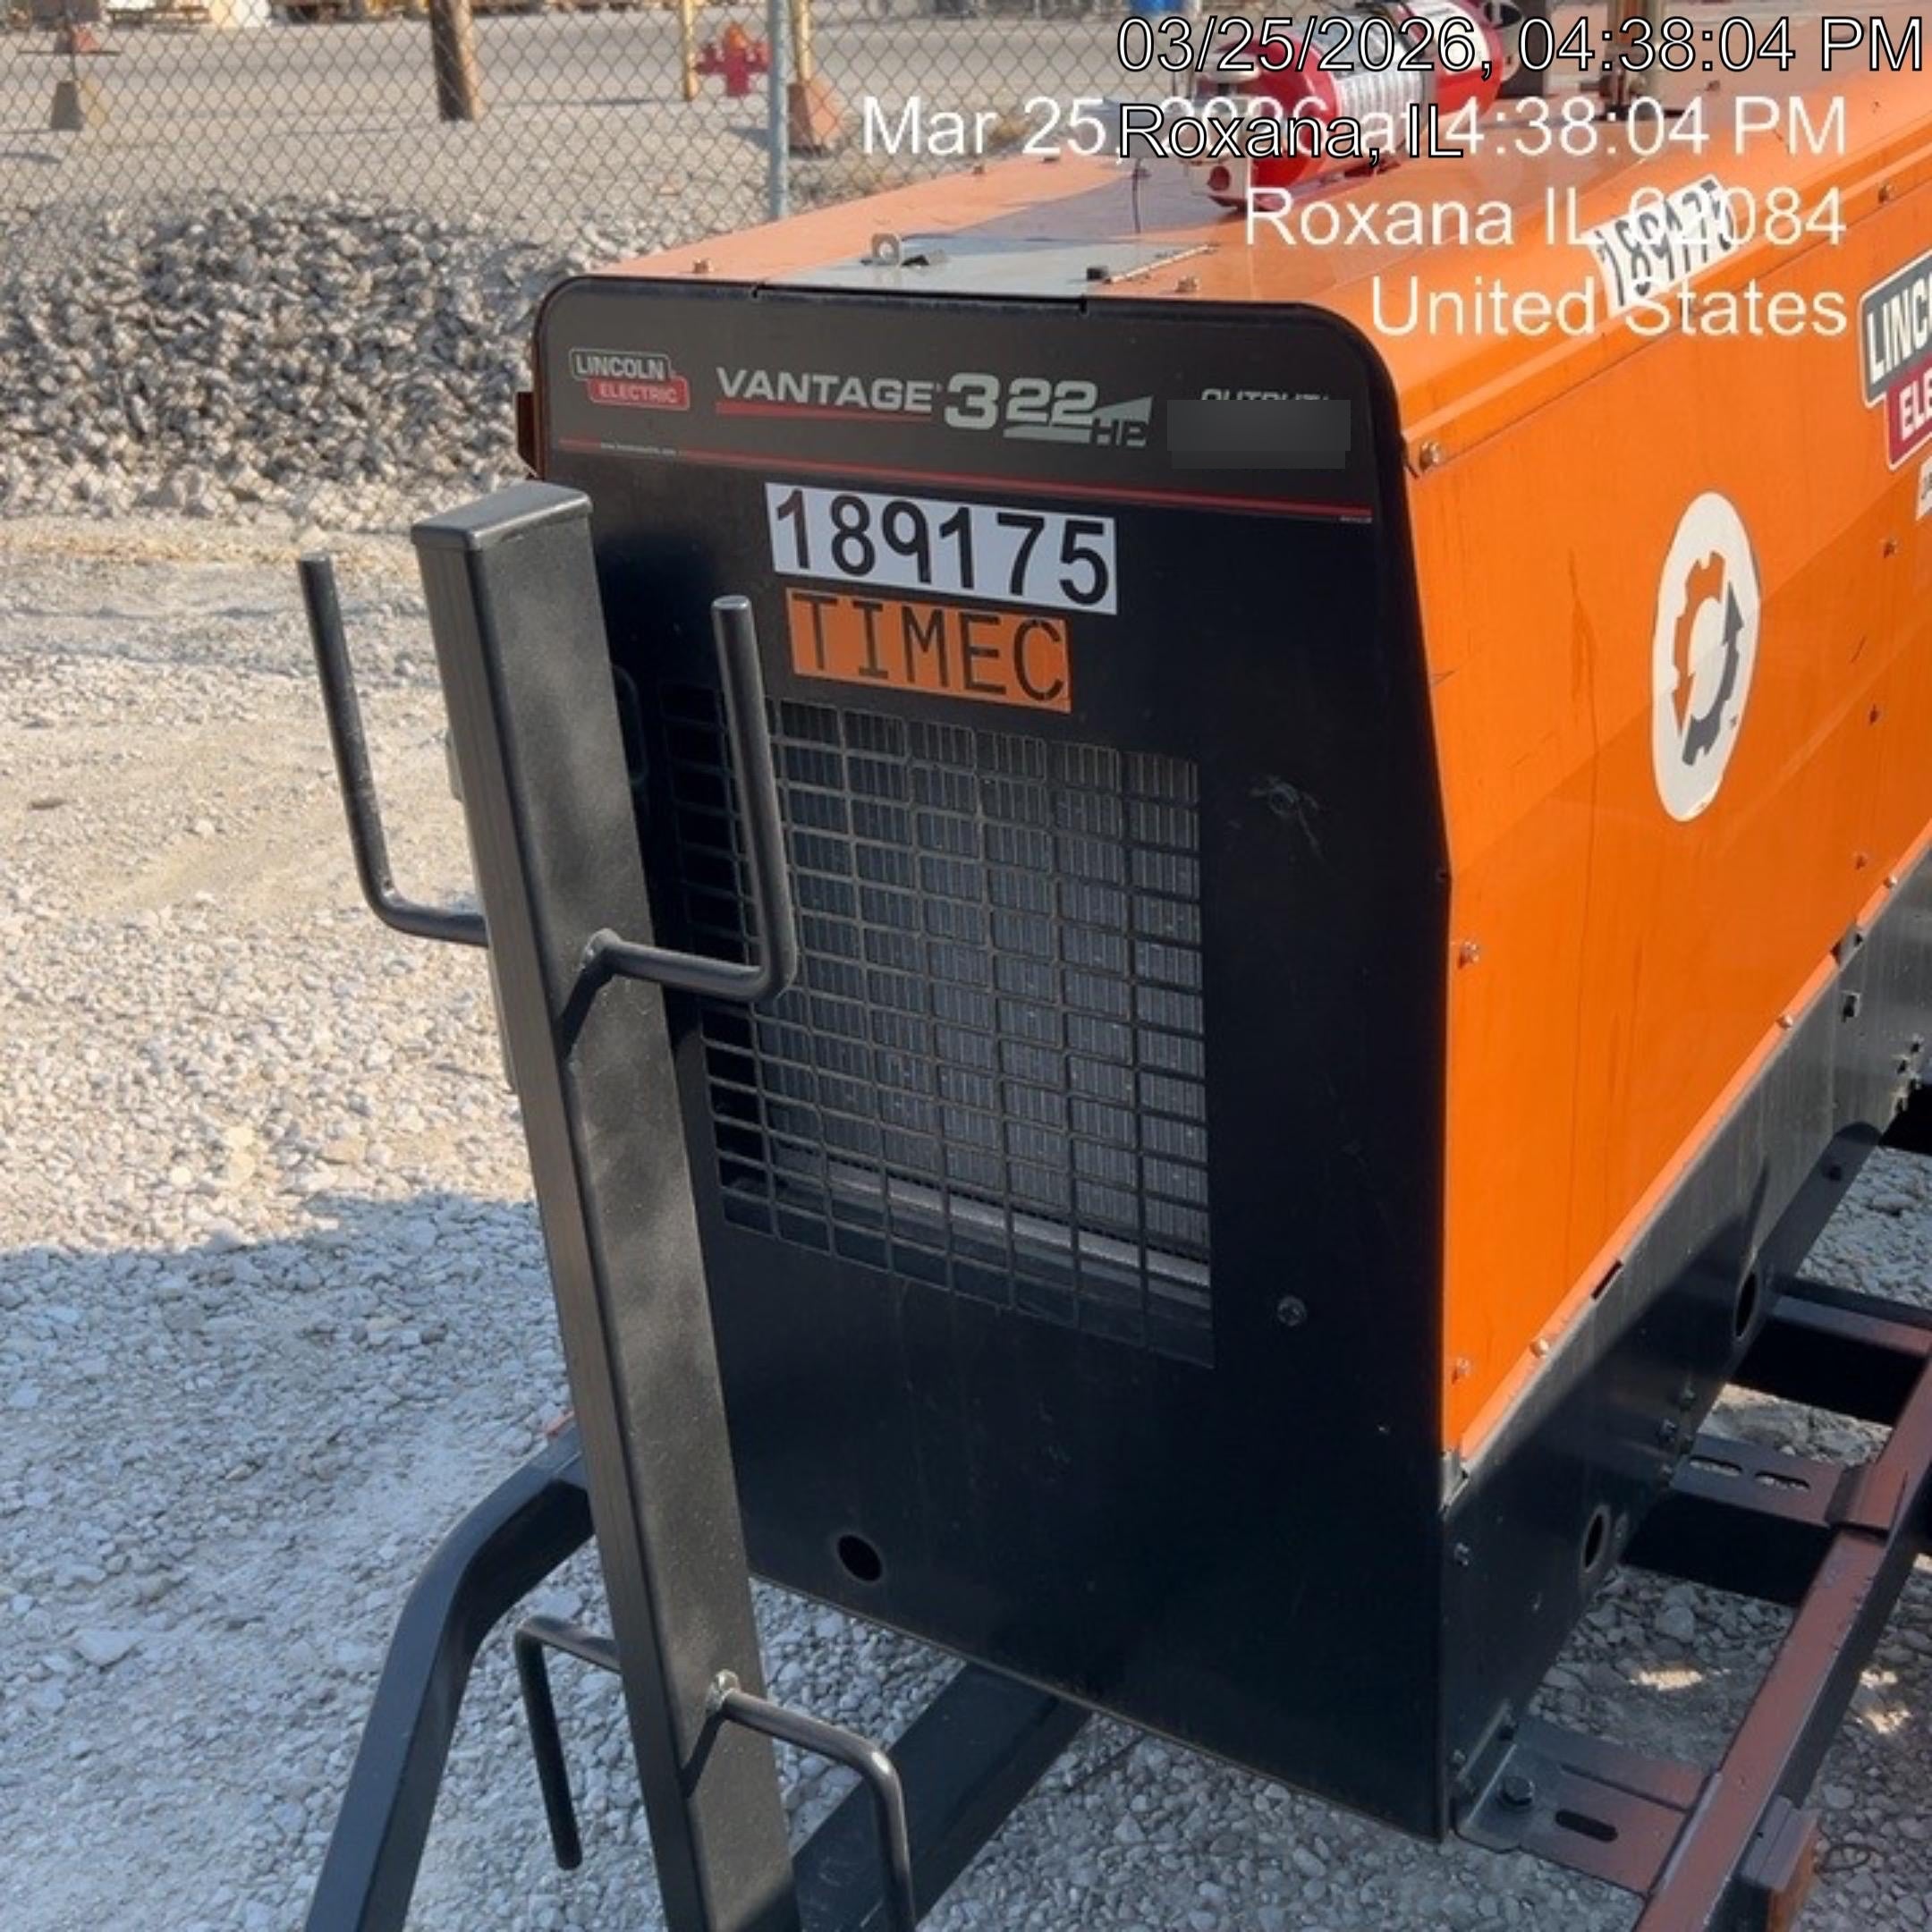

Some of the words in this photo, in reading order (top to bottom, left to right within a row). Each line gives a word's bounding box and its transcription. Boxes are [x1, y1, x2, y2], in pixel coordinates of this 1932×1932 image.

[576, 354, 665, 381] LINCOLN
[1867, 267, 1932, 385] LINC
[599, 382, 678, 403] ELECTRIC
[716, 367, 933, 412] VANTAGE
[944, 372, 1098, 430] 322
[776, 488, 1108, 606] 189175
[792, 592, 1063, 701] TIMEC
